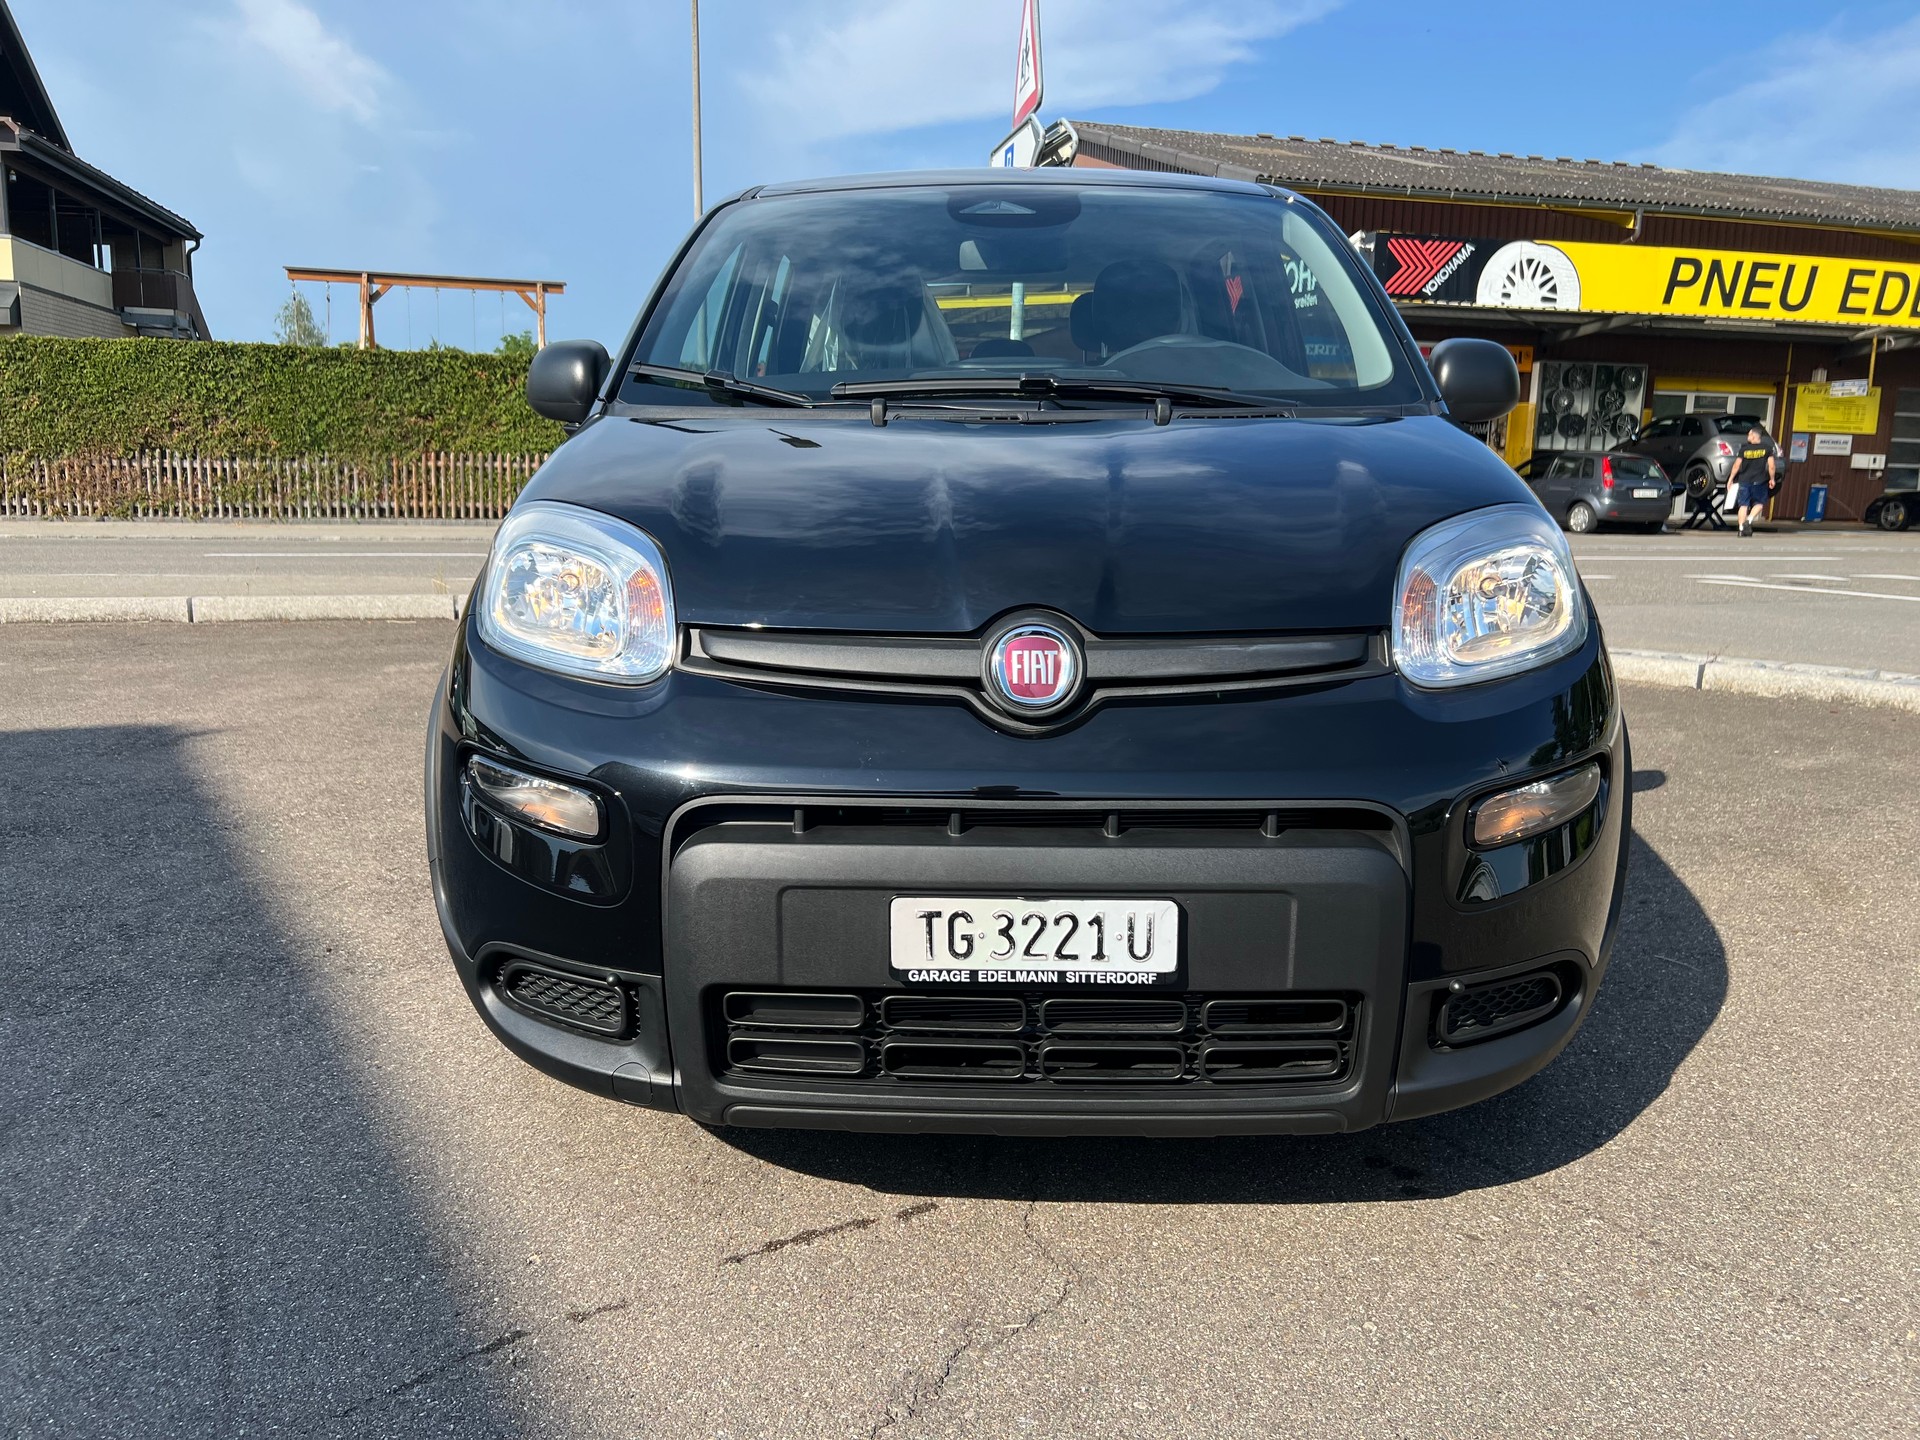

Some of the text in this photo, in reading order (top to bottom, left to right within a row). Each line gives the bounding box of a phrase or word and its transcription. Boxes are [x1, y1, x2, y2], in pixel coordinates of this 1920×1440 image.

[1421, 242, 1476, 296] YOKOHAMA
[1662, 256, 1819, 312] PNEU
[1011, 650, 1058, 685] FIAT
[915, 910, 1156, 963] TG 3221 U
[907, 969, 1158, 985] GARAGE EDELMANN SITTERDORF
